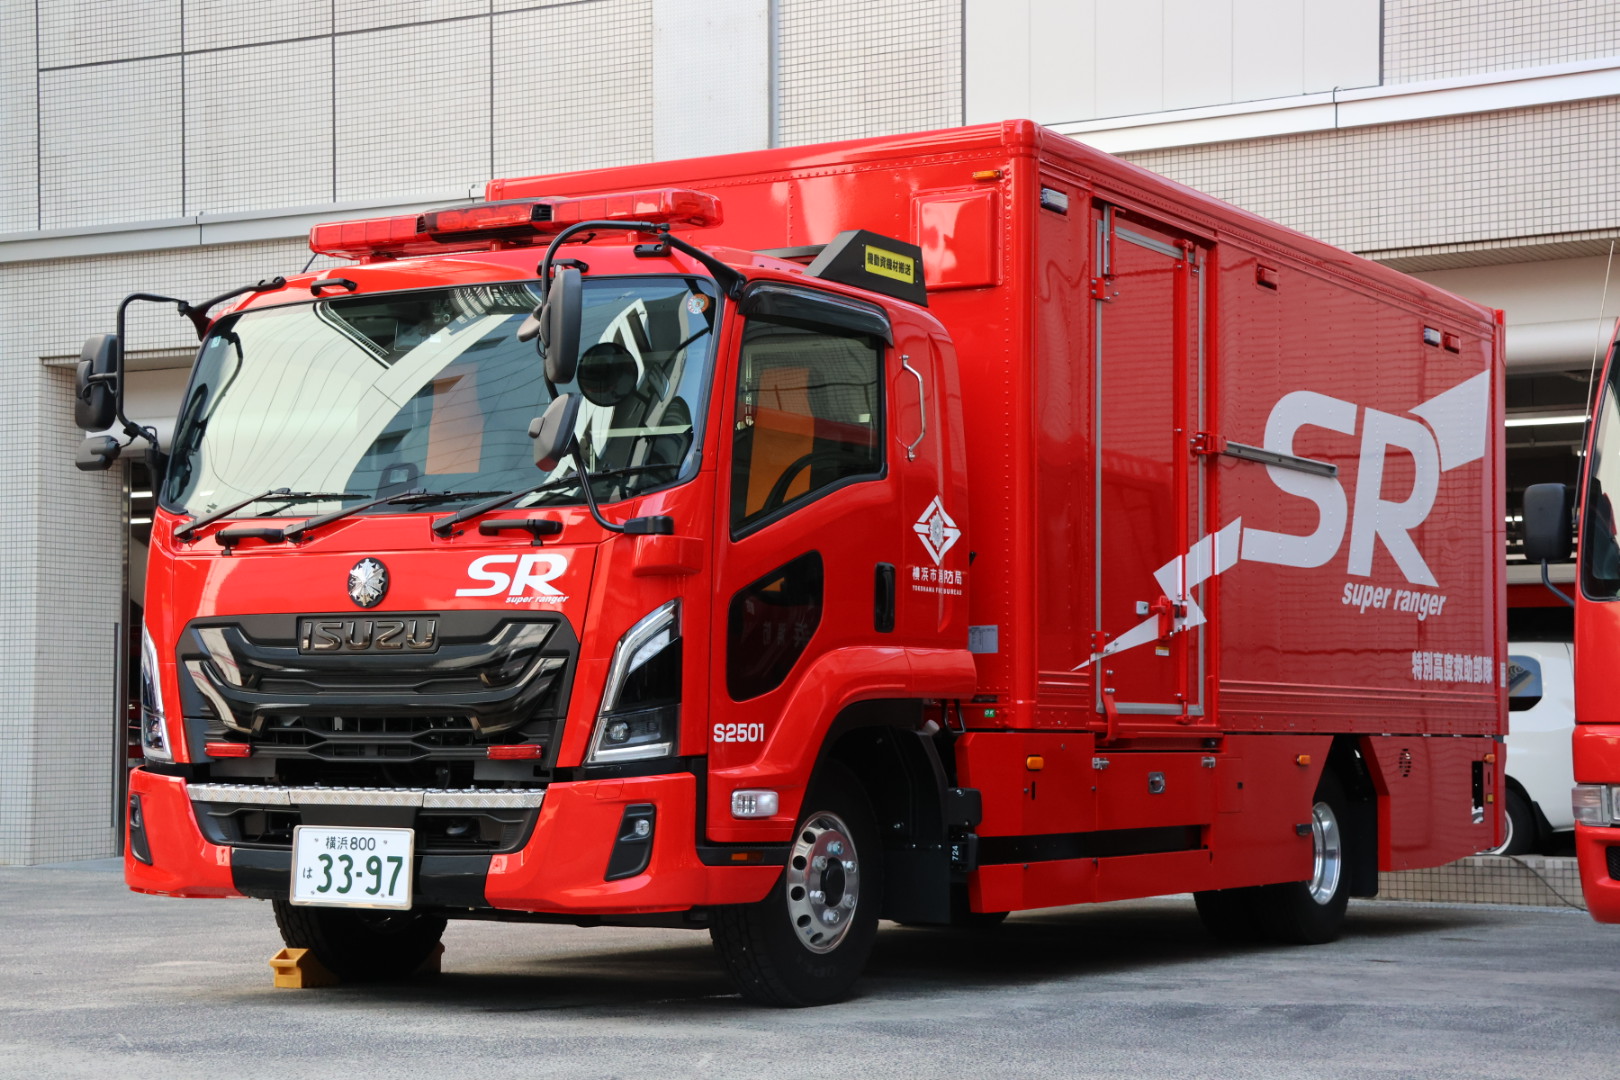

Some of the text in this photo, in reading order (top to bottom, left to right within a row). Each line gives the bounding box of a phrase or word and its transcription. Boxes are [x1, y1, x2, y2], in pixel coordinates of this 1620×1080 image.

[1241, 390, 1440, 588] SR
[455, 553, 568, 597] SR
[912, 566, 962, 585] 横浜市消防局
[505, 595, 569, 605] super ranger
[1341, 582, 1447, 621] super ranger
[302, 620, 436, 651] ISUZU
[1412, 650, 1493, 684] 特別高度救助部隊
[713, 723, 765, 743] S2501
[951, 845, 959, 861] 724
[302, 853, 404, 897] は 33-97
